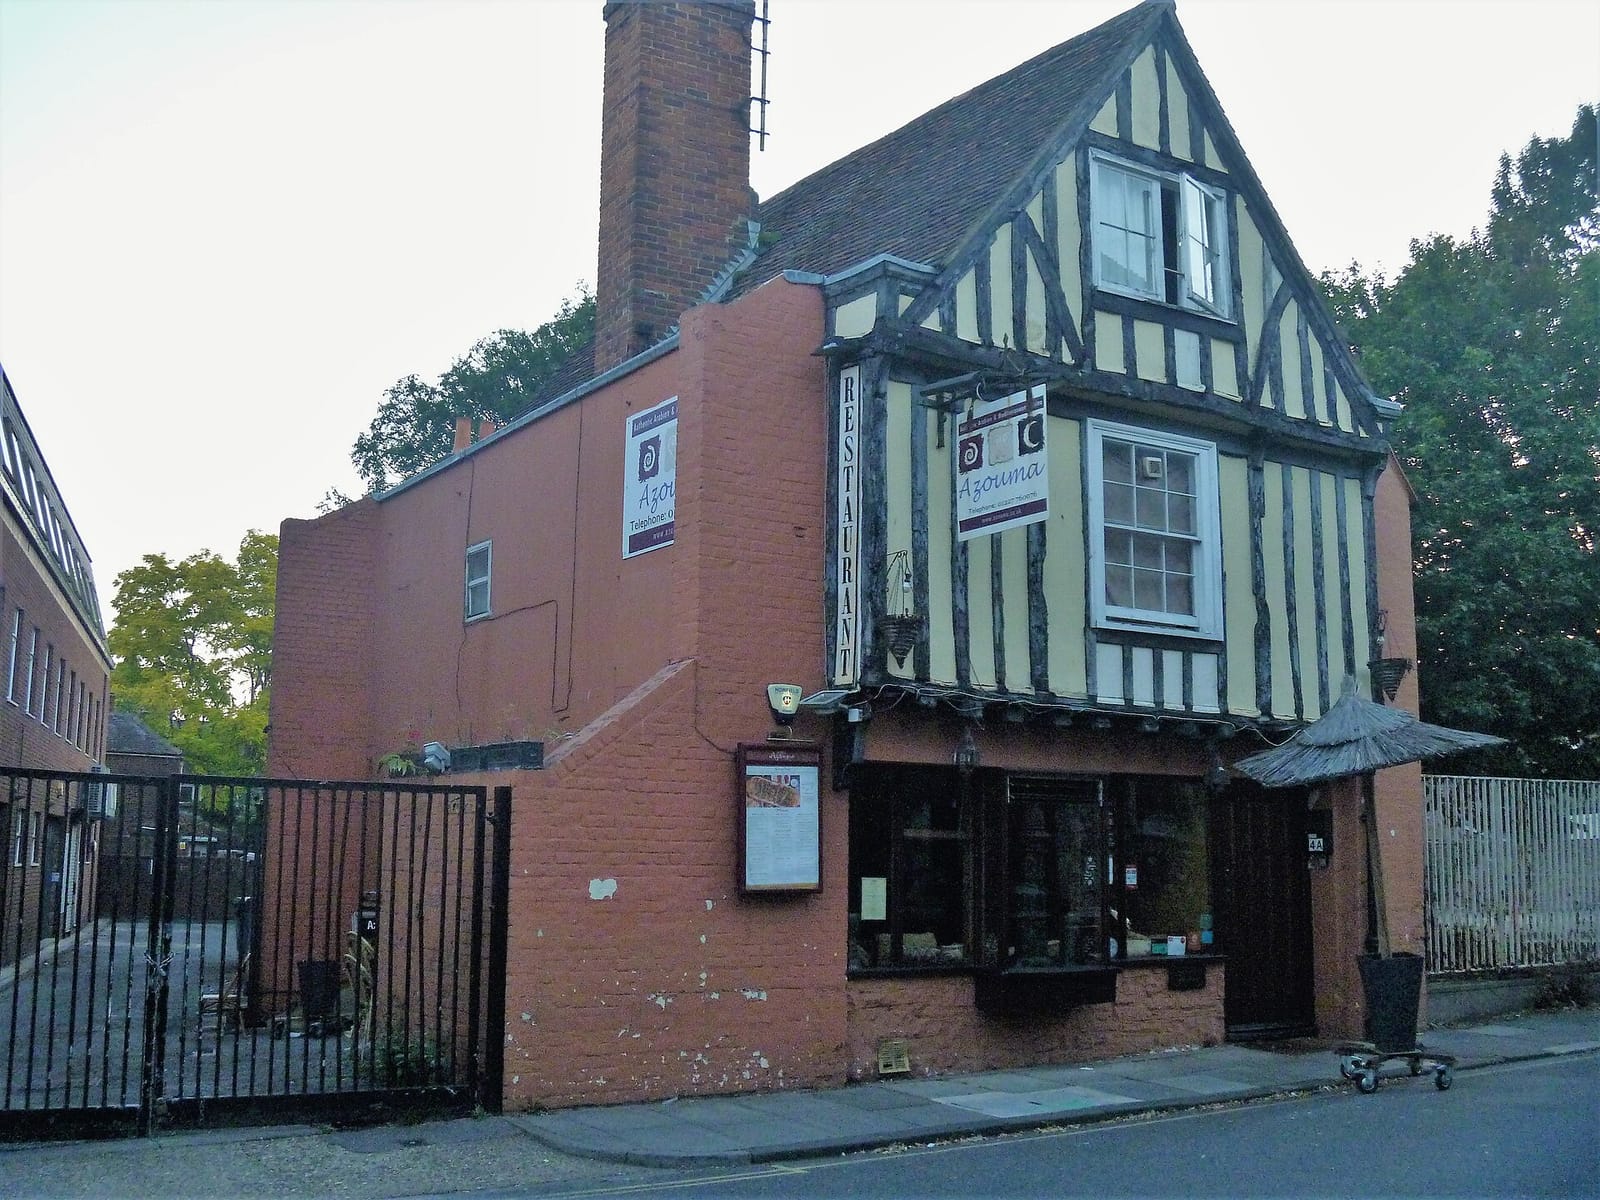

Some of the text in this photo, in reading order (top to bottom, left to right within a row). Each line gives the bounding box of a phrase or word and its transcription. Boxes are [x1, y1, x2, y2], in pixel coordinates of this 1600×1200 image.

[958, 462, 1046, 503] Azouma
[629, 512, 666, 531] Telephone:
[840, 376, 855, 677] RESTAURANT
[1309, 840, 1323, 850] 4A
